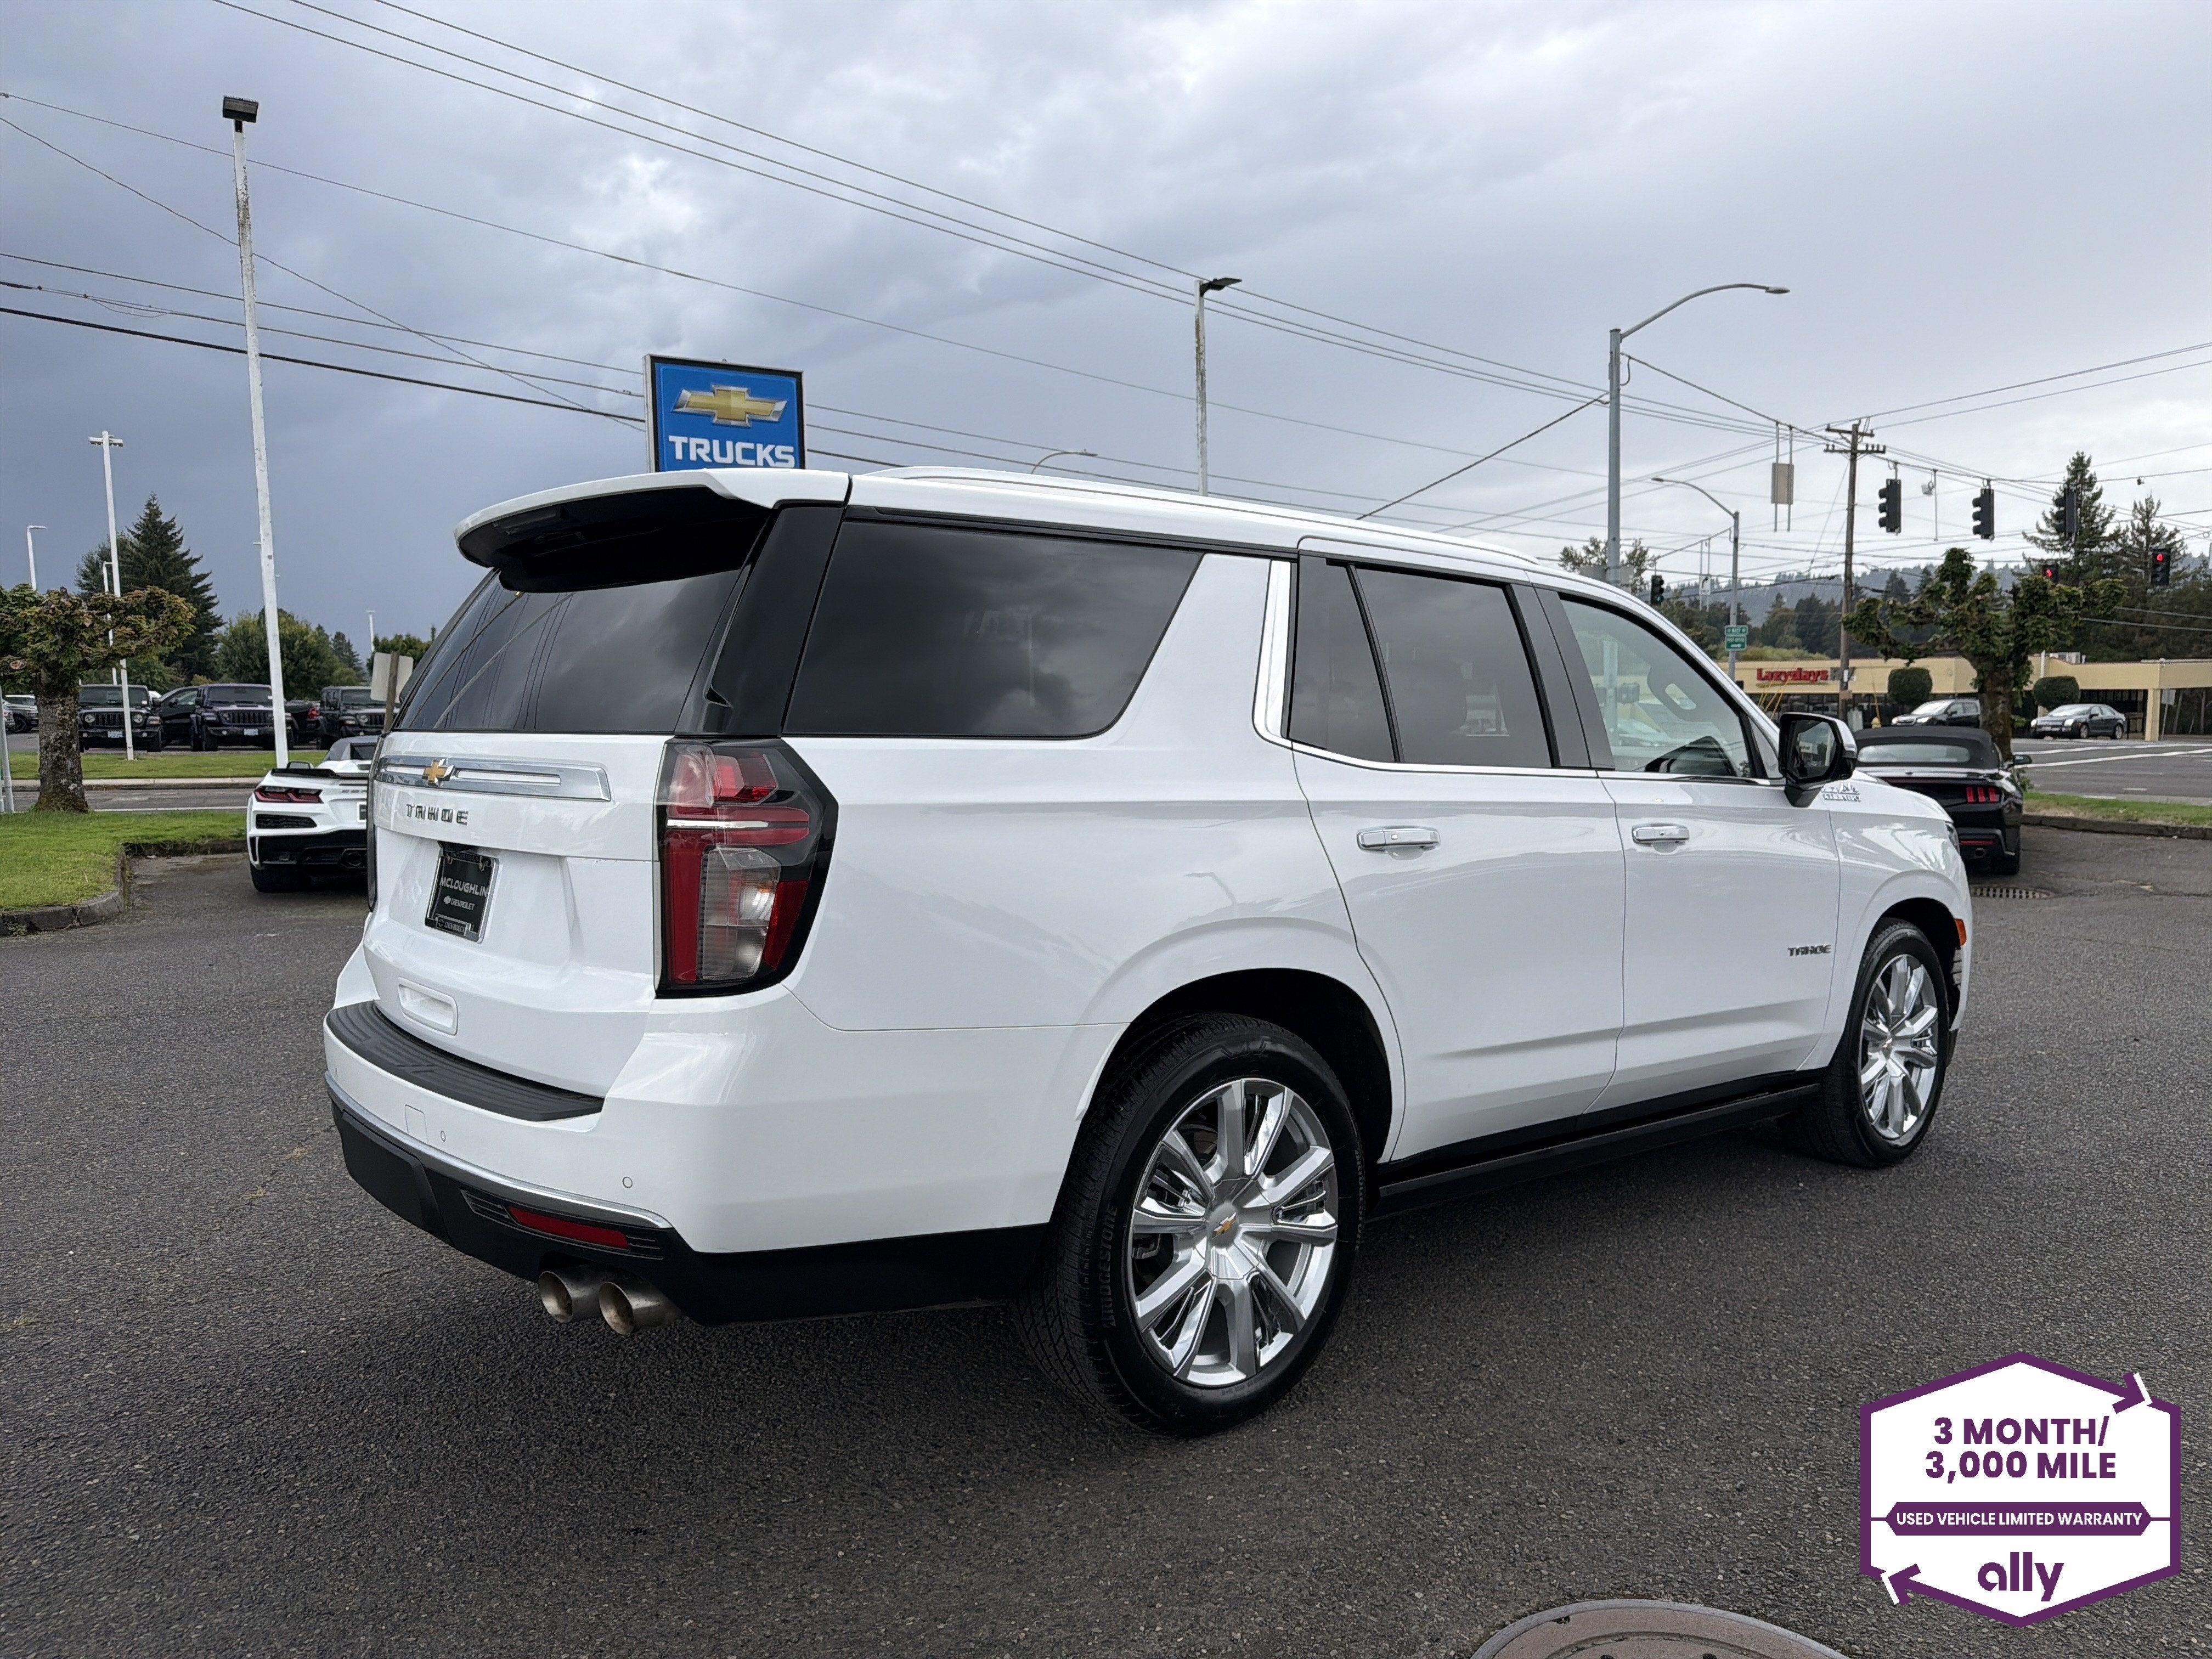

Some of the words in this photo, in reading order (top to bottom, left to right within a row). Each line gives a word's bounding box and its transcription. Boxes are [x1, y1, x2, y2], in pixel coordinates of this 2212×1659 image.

[668, 435, 795, 469] TRUCKS
[1757, 668, 1829, 682] Lazydays
[406, 804, 469, 825] TAHOE
[439, 876, 488, 898] MCLOUGHLIN
[450, 898, 475, 911] CHEVROLET
[1787, 944, 1831, 957] TAHOE
